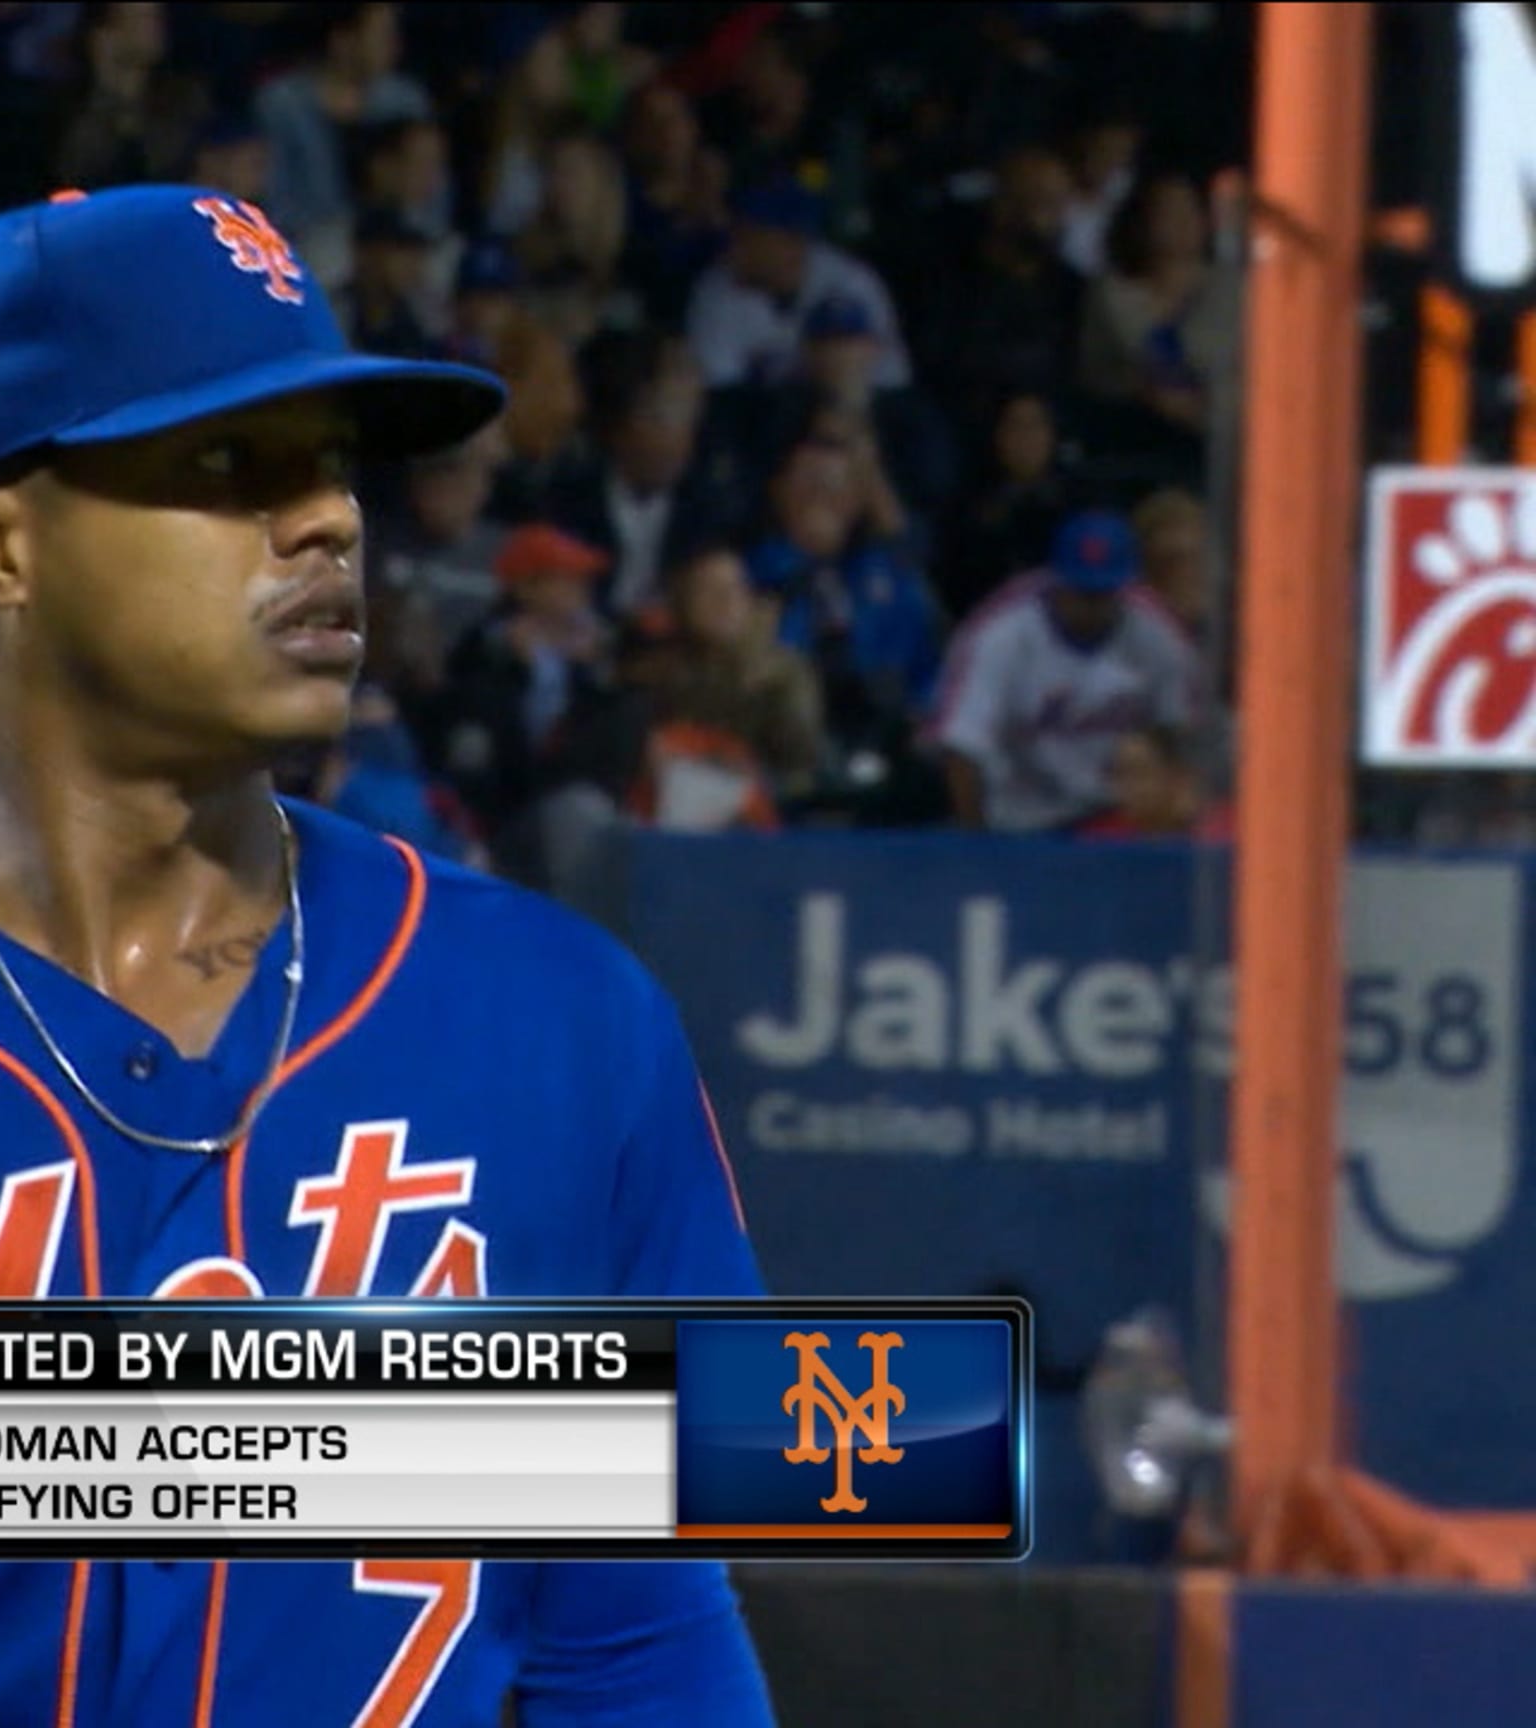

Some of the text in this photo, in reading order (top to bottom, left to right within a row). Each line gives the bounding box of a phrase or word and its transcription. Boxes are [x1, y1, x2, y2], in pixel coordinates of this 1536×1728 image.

[1341, 970, 1490, 1077] 58
[749, 1092, 1168, 1159] Casino Hotel
